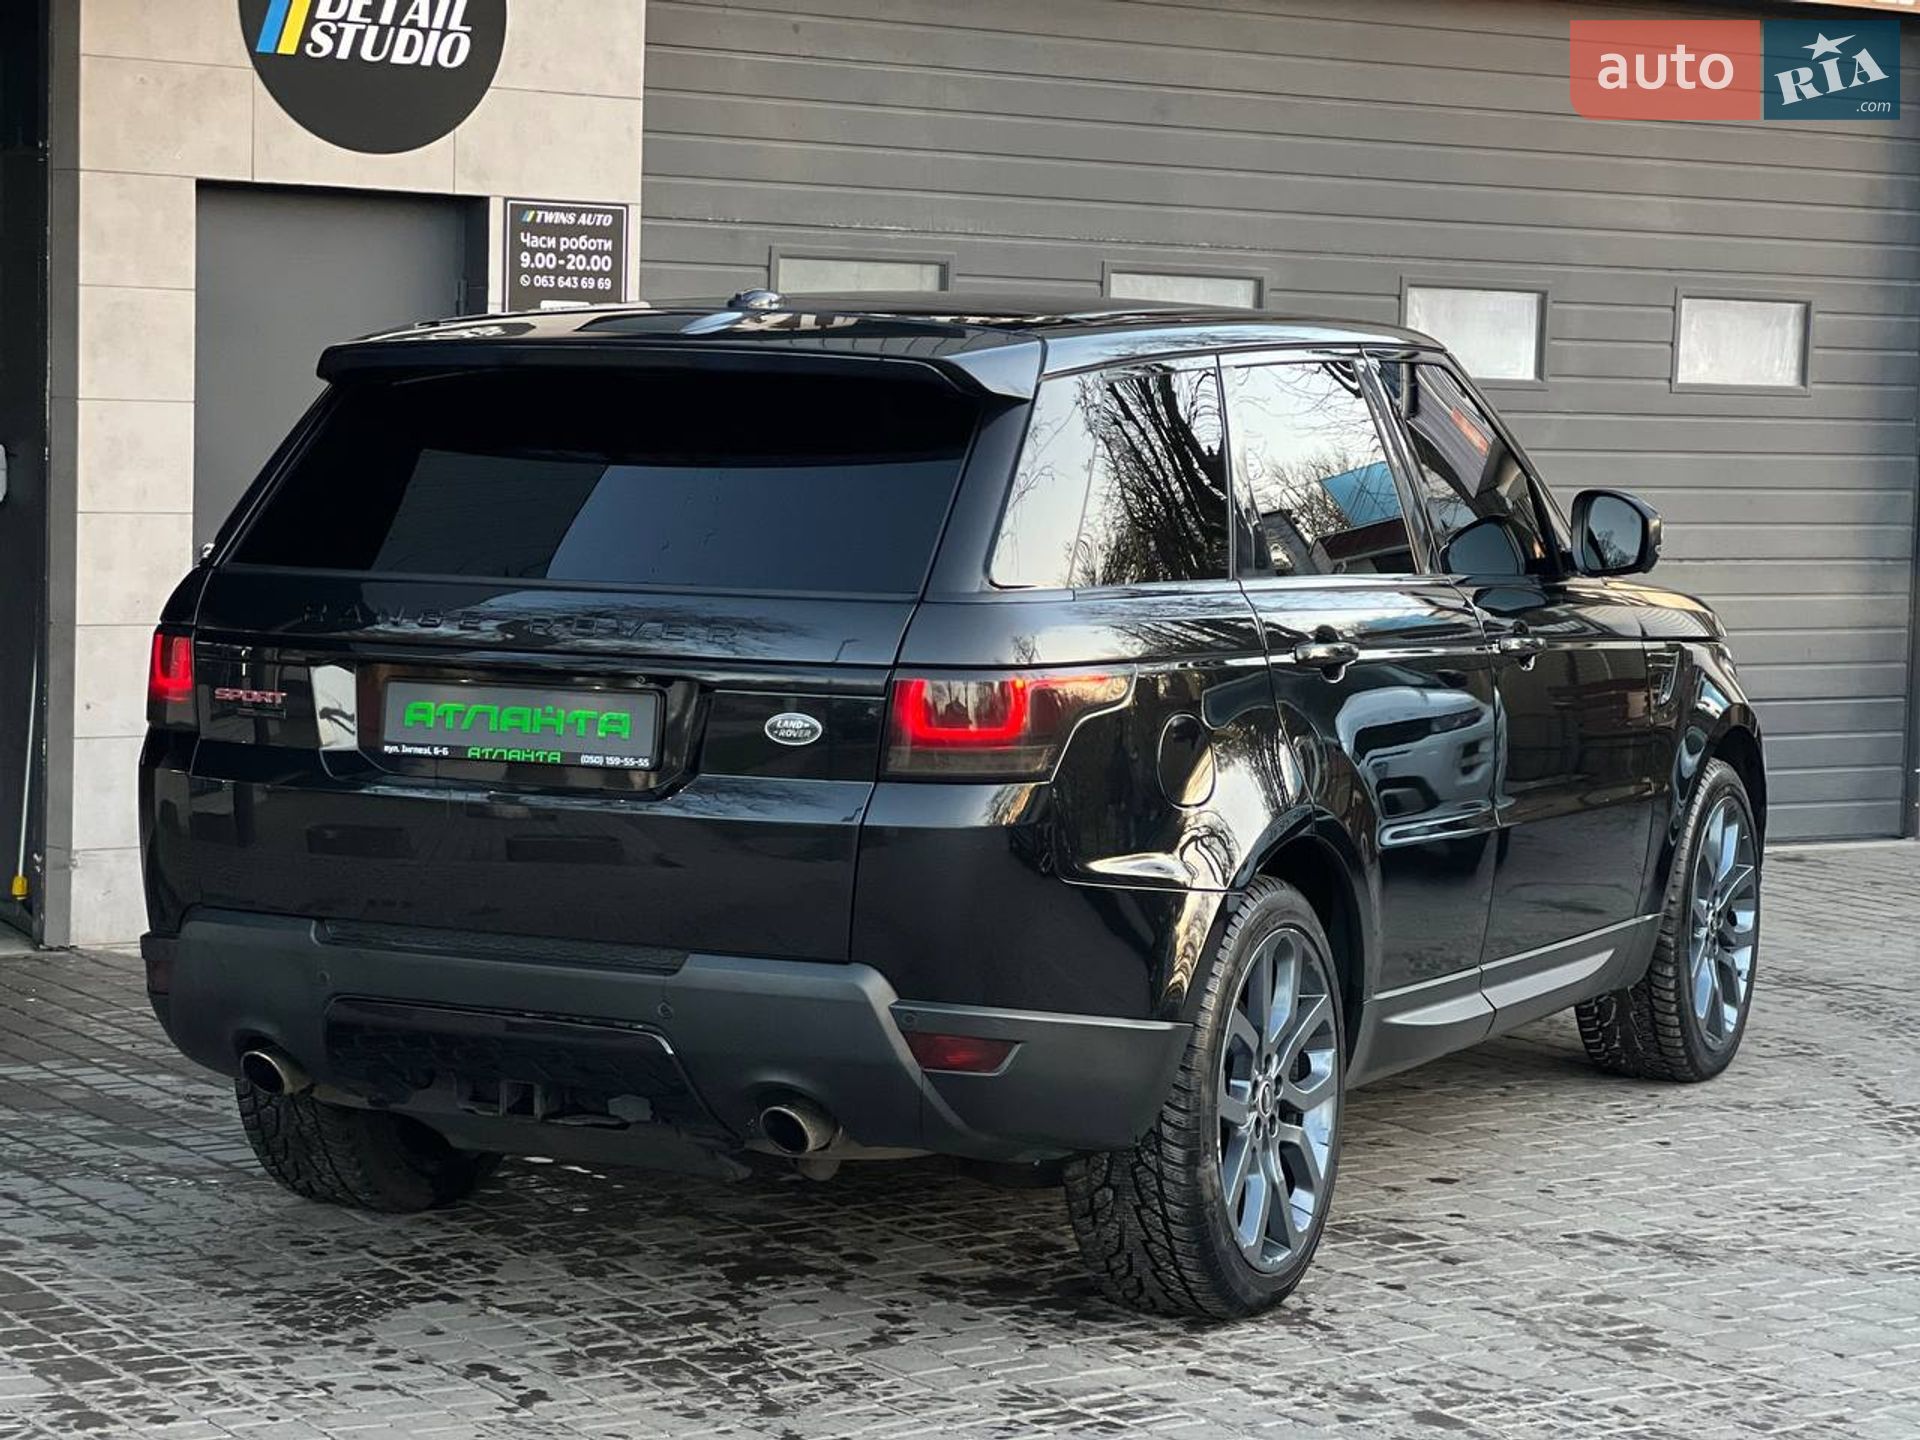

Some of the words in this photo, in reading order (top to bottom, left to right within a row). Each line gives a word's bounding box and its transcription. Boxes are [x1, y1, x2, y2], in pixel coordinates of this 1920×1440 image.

[304, 20, 472, 69] STUDIO
[535, 210, 577, 225] TWINS
[577, 212, 614, 227] AUTO
[520, 231, 556, 248] Часи
[559, 235, 613, 252] роботи
[533, 274, 556, 288] 063
[557, 276, 579, 290] 643
[580, 276, 596, 290] 69
[597, 277, 612, 291] 69
[214, 687, 288, 704] SPORT
